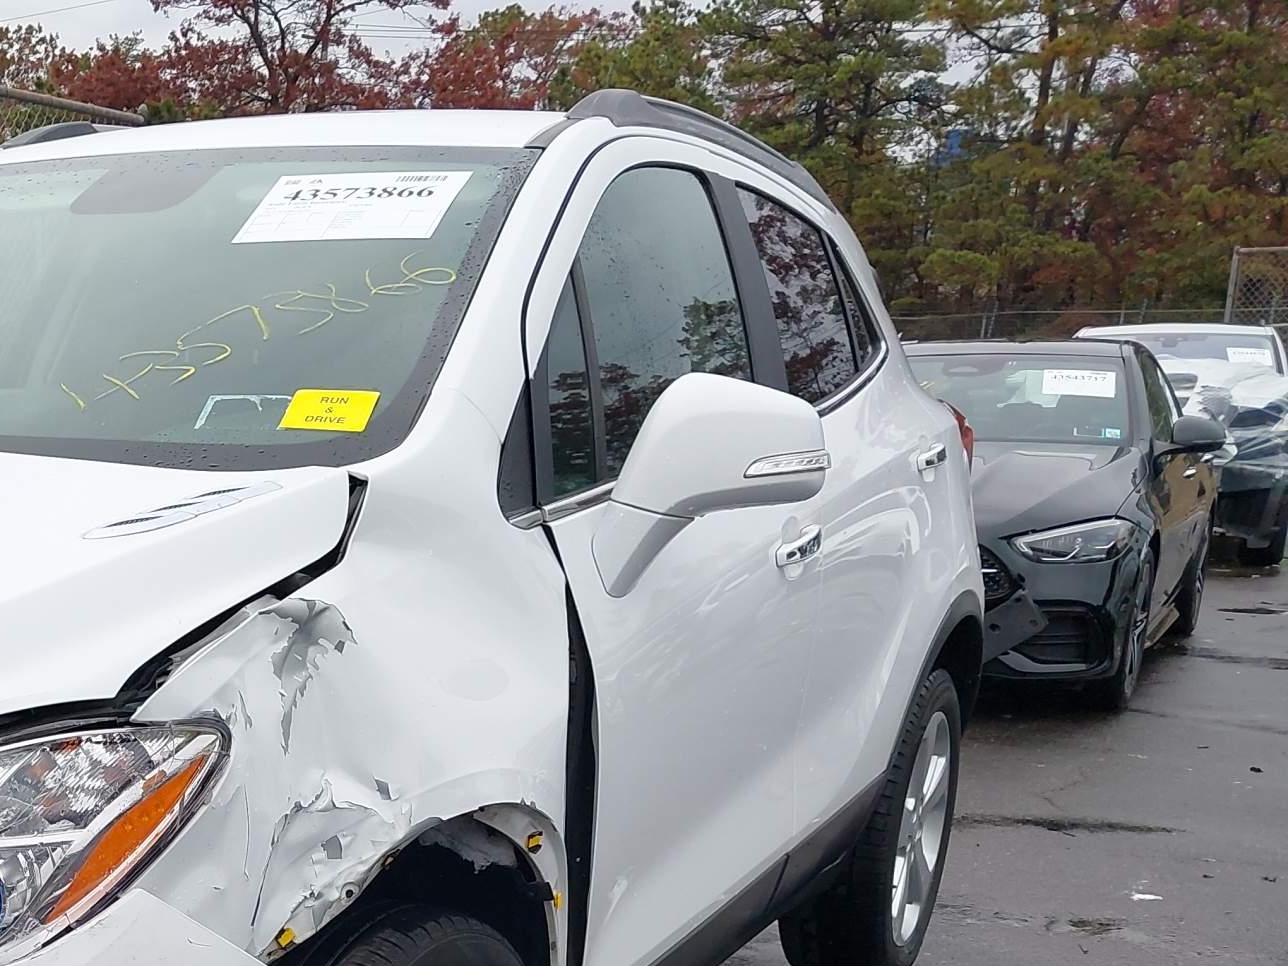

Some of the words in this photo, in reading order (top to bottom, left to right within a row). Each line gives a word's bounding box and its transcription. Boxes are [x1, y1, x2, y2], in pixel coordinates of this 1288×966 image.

[283, 185, 438, 201] 43573866
[319, 396, 350, 405] RUN
[324, 406, 334, 414] &
[304, 415, 346, 424] DRIVE
